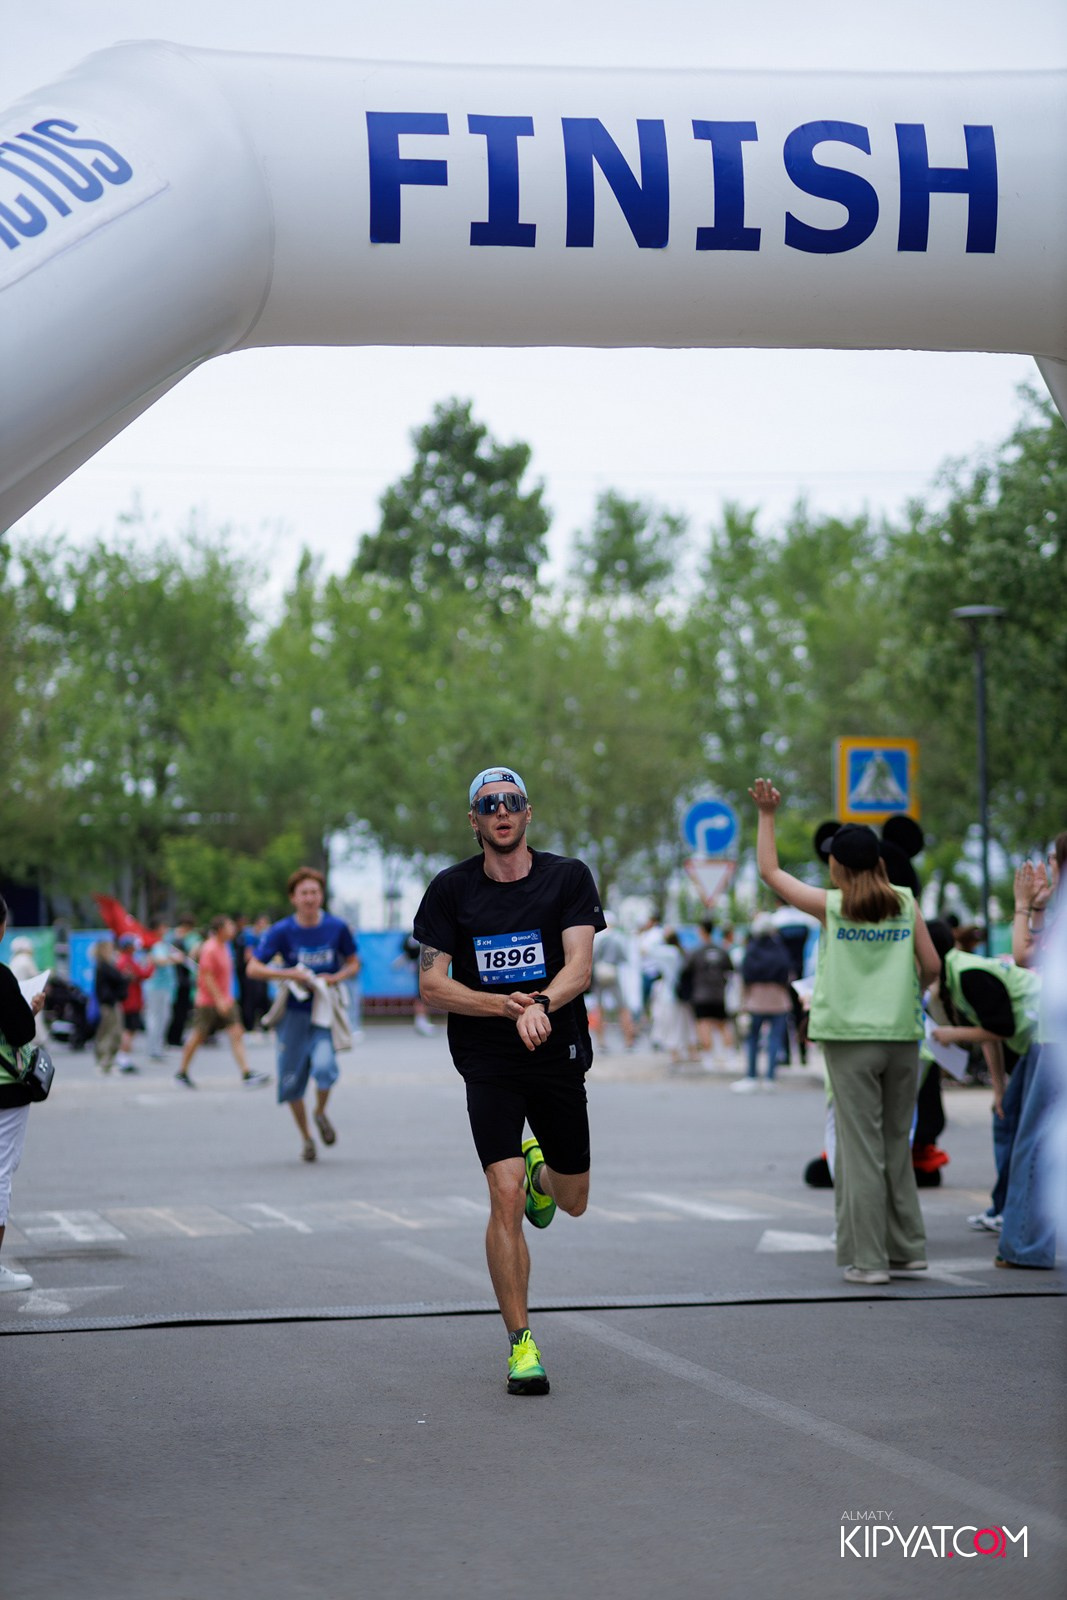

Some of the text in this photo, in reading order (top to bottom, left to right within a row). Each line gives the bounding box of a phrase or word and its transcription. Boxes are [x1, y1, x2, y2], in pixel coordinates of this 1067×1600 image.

[366, 111, 999, 254] FINISH
[837, 928, 910, 942] ВОЛОНТЕР
[484, 946, 536, 969] 1896
